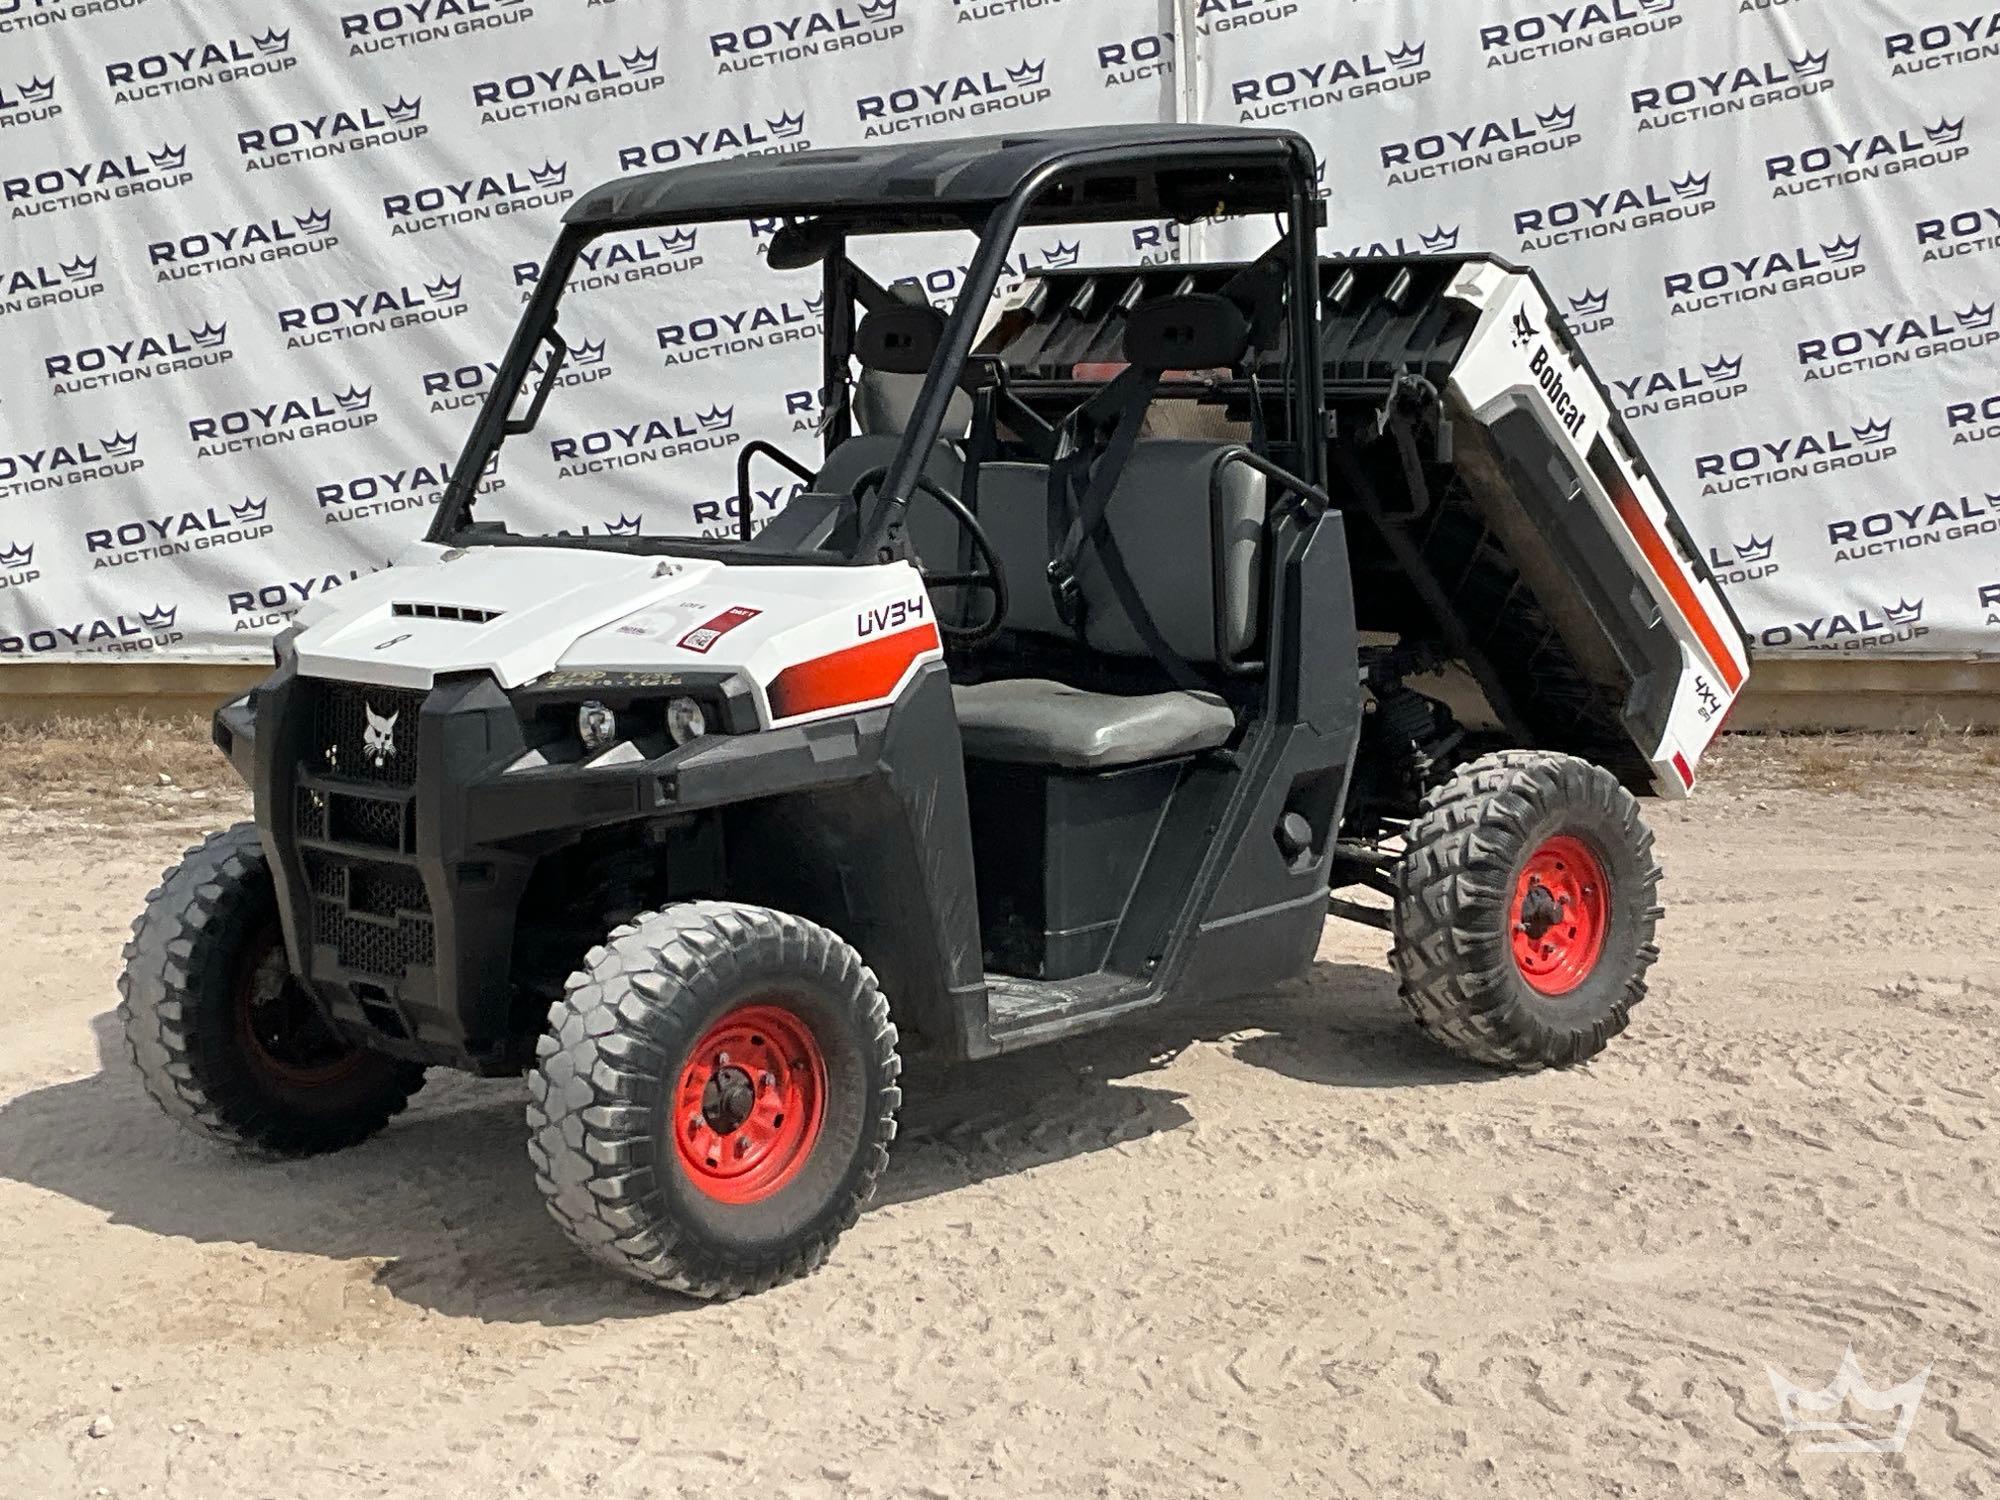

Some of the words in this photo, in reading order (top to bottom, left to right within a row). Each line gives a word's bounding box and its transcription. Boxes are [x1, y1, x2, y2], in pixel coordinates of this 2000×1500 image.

[0, 9, 66, 33] CTION
[350, 26, 449, 57] AUCTION
[454, 8, 533, 34] GROUP
[710, 8, 860, 57] ROYAL
[957, 0, 1060, 23] AUCTIO
[1215, 4, 1298, 32] GROUP
[1480, 0, 1637, 50] ROYAL
[106, 40, 254, 87] ROYAL
[718, 43, 818, 75] AUCTION
[824, 25, 904, 52] GROUP
[1487, 34, 1593, 68] AUCTION
[1599, 15, 1682, 43] GROUP
[115, 73, 214, 104] AUCTION
[218, 57, 297, 83] GROUP
[473, 59, 621, 107] ROYAL
[857, 72, 1007, 121] ROYAL
[1105, 62, 1173, 88] AUCTI
[1232, 55, 1386, 105] ROYAL
[1241, 90, 1343, 121] AUCTION
[1348, 70, 1431, 98] GROUP
[1631, 63, 1789, 113] ROYAL
[0, 105, 62, 128] ROUP
[482, 93, 581, 125] AUCTION
[586, 76, 664, 102] GROUP
[865, 107, 965, 138] AUCTION
[970, 89, 1051, 115] GROUP
[1638, 98, 1744, 133] AUCTION
[1750, 79, 1834, 107] GROUP
[238, 108, 385, 154] ROYAL
[246, 141, 345, 172] AUCTION
[349, 125, 428, 151] GROUP
[619, 123, 767, 171] ROYAL
[1380, 117, 1536, 168] ROYAL
[3, 155, 150, 202] ROYAL
[1387, 153, 1493, 187] AUCTION
[1498, 134, 1581, 162] GROUP
[1766, 130, 1924, 181] ROYAL
[1773, 165, 1879, 199] AUCTION
[1884, 147, 1969, 175] GROUP
[12, 189, 110, 220] AUCTION
[115, 172, 193, 198] GROUP
[383, 173, 531, 219] ROYAL
[392, 206, 490, 236] AUCTION
[495, 190, 573, 215] GROUP
[1514, 184, 1671, 235] ROYAL
[148, 220, 296, 266] ROYAL
[1521, 219, 1626, 253] AUCTION
[1632, 200, 1716, 228] GROUP
[1922, 235, 2000, 262] AUCTI
[157, 253, 255, 283] AUCTION
[260, 237, 339, 262] GROUP
[513, 239, 660, 286] RYAL
[521, 273, 619, 304] ATION
[625, 256, 704, 282] GROUP
[1664, 248, 1821, 298] ROYAL
[27, 283, 104, 309] GROUP
[278, 287, 425, 333] ROYAL
[1671, 283, 1777, 315] AUCTION
[1782, 264, 1866, 292] GROUP
[287, 320, 385, 350] AUCTION
[390, 304, 468, 329] GROUP
[657, 303, 805, 349] ROYAL
[1797, 314, 1955, 364] ROYAL
[45, 333, 191, 379] ROYAL
[53, 366, 151, 397] AUCTION
[156, 350, 233, 375] GROUP
[665, 336, 764, 366] AUCTION
[1804, 350, 1910, 382] AUCTION
[1915, 331, 2000, 358] GROUP
[1529, 345, 1587, 438] Bobcat
[1612, 367, 1702, 400] YAL
[1665, 384, 1747, 411] GROUP
[189, 397, 336, 441] ROYAL
[197, 429, 295, 459] AUCTION
[300, 414, 377, 438] GROUP
[550, 417, 697, 462] ROYAL
[0, 443, 102, 479] OYAL
[0, 475, 62, 498] CTION
[67, 459, 145, 484] GROUP
[559, 449, 656, 479] AUCTION
[662, 433, 740, 458] GROUP
[1695, 431, 1852, 479] ROYAL
[1702, 465, 1808, 496] AUCTION
[1813, 447, 1897, 474] GROUP
[85, 508, 231, 553] ROYAL
[325, 495, 423, 525] AUCTION
[1827, 497, 1985, 545] ROYAL
[94, 540, 190, 570] AUCTION
[195, 525, 273, 549] GROUP
[1835, 531, 1941, 563] AUCTION
[1946, 519, 2000, 540] GRO
[1715, 563, 1779, 586] ROUP
[0, 616, 141, 652] ROYAL
[234, 609, 298, 632] AUCT
[858, 595, 922, 636] UV34
[1844, 627, 1929, 651] GROUP
